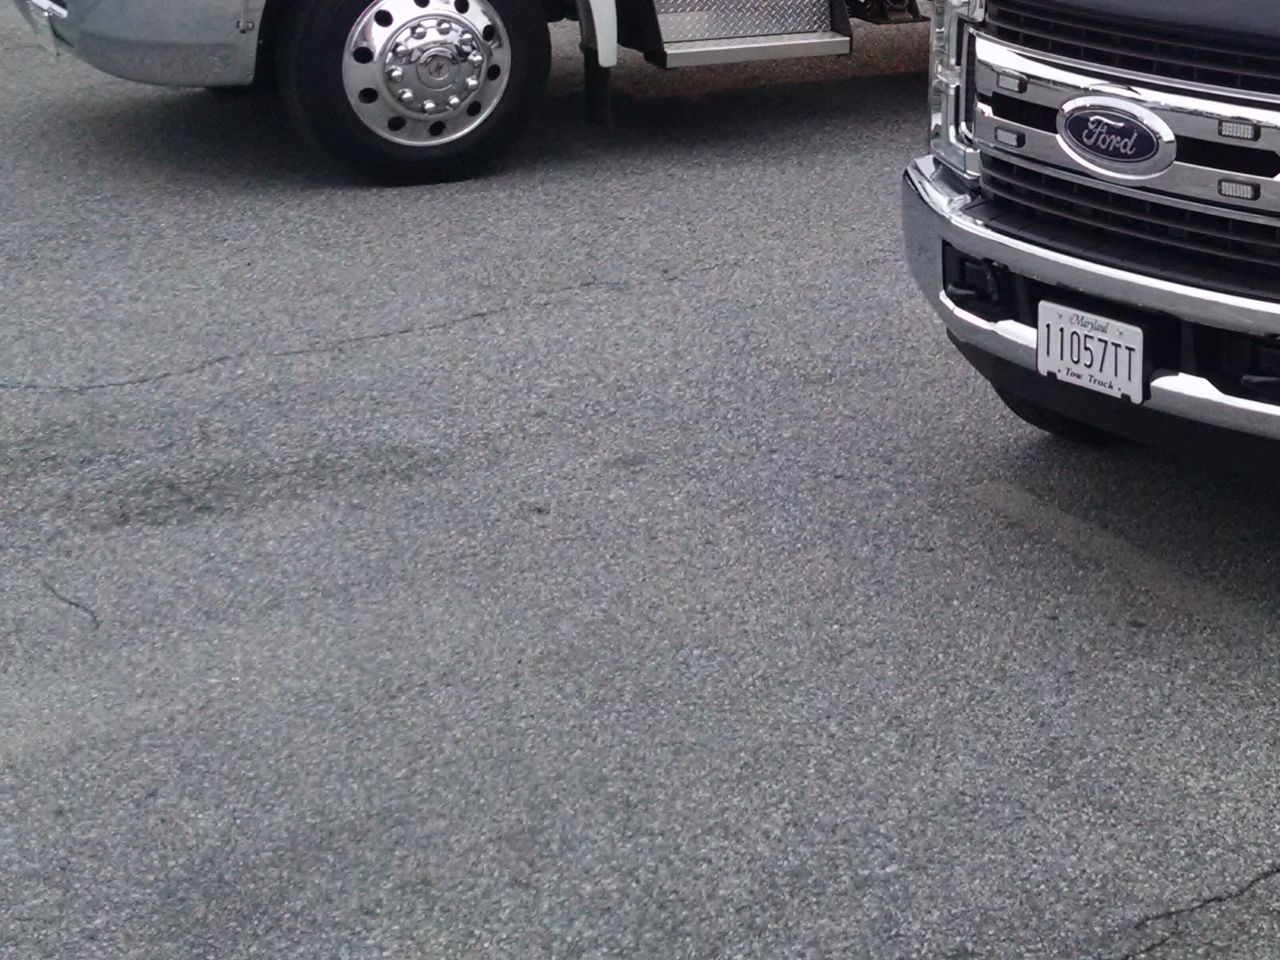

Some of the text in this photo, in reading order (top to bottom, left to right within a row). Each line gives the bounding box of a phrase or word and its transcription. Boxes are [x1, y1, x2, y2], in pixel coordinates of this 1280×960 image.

[1082, 115, 1138, 155] Ford
[1070, 313, 1110, 334] Maryland
[1045, 322, 1136, 382] 11057TT
[1065, 367, 1114, 390] Tow Truck
